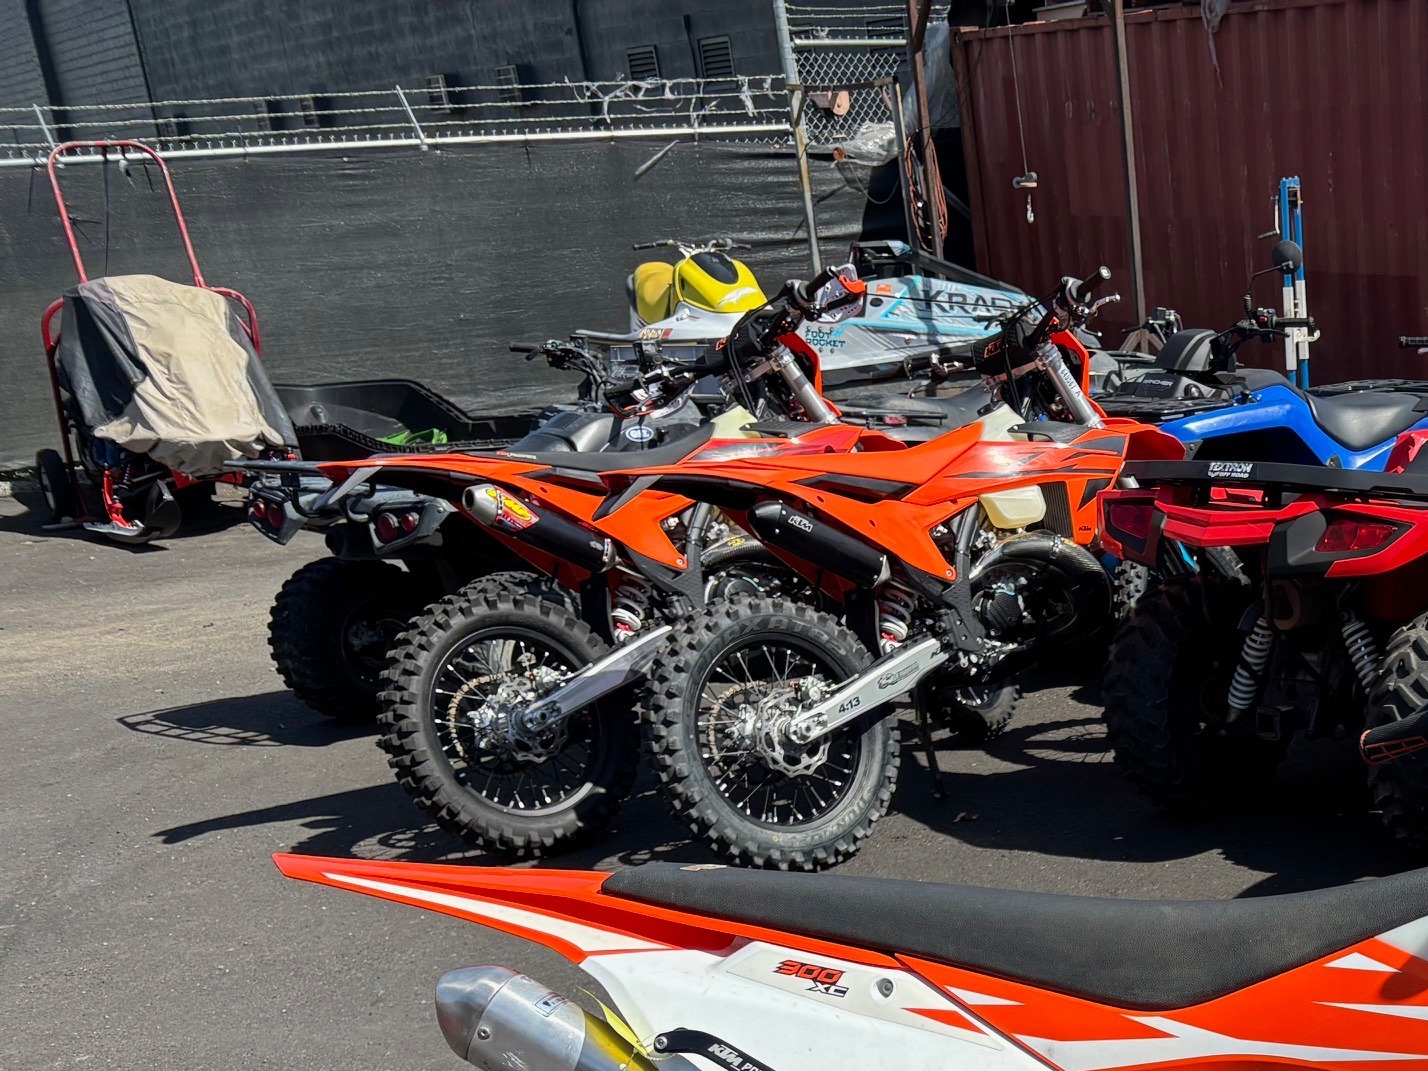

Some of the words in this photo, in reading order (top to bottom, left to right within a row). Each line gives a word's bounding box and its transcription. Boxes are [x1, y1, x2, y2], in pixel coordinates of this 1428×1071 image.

[1208, 462, 1253, 473] TEXTRON
[788, 515, 813, 533] KTM
[773, 959, 846, 985] 300
[806, 980, 849, 998] XC
[708, 1043, 743, 1068] KTM
